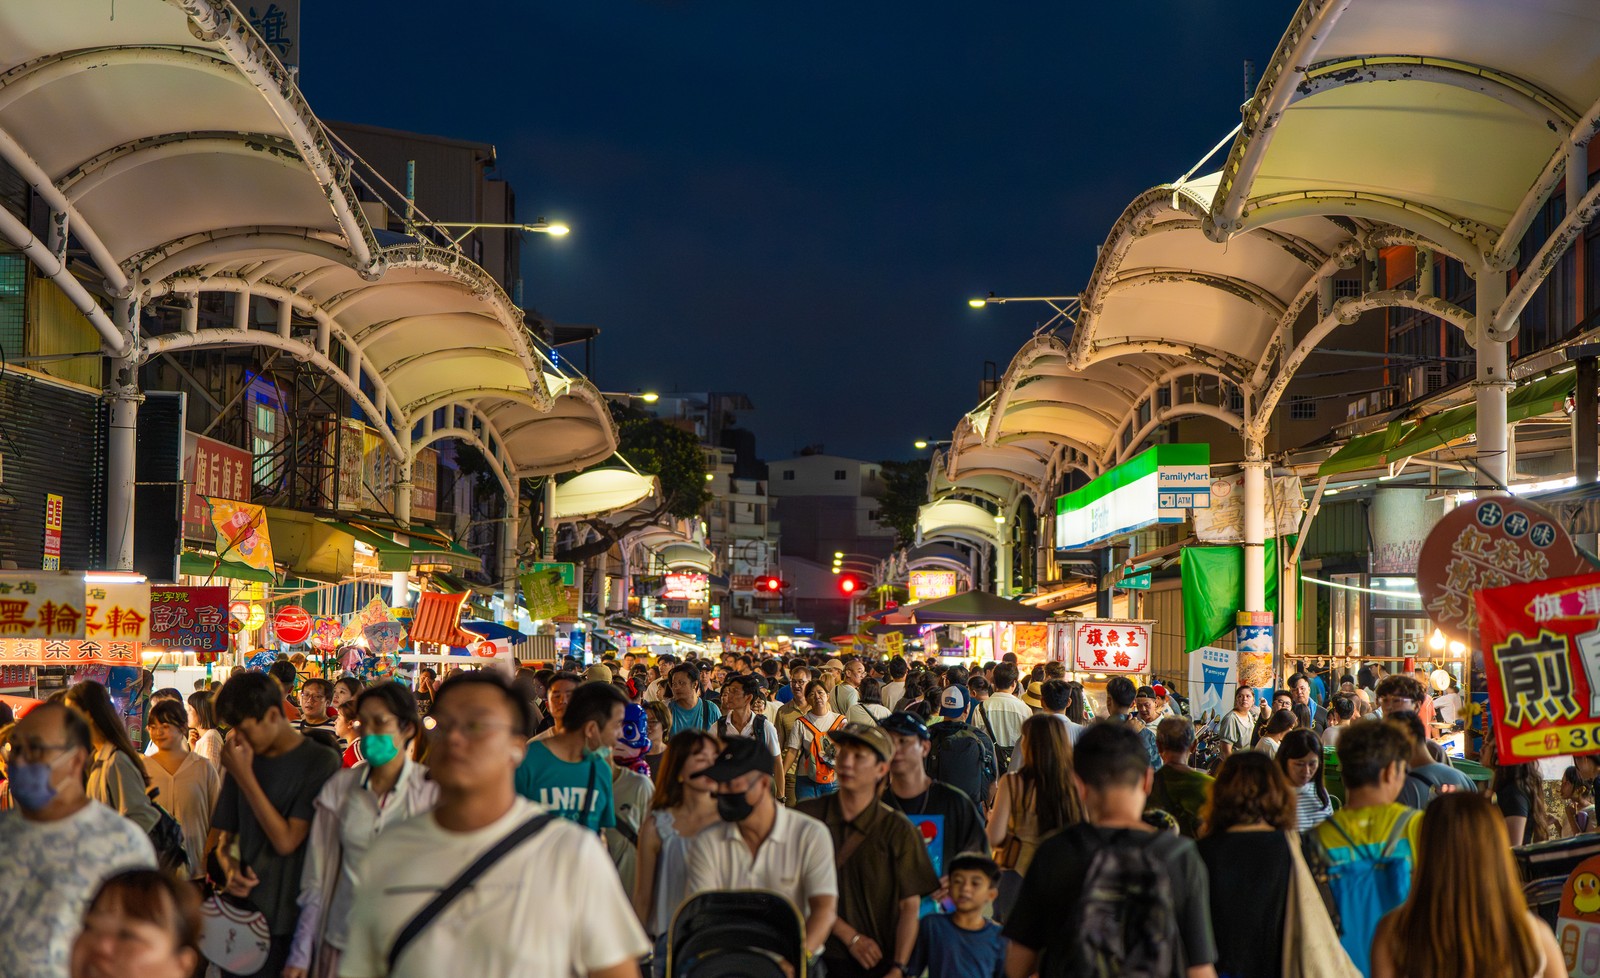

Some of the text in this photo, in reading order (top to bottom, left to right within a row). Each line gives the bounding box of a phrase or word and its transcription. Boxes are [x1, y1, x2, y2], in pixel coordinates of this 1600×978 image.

[1160, 472, 1208, 482] FamilyMart
[1178, 496, 1191, 505] ATM
[1481, 503, 1551, 546] 古早味
[1453, 524, 1549, 580] 紅茶冰
[1532, 587, 1600, 623] 旗津
[0, 600, 82, 636] 黑輪
[151, 605, 226, 633] 魷魚
[161, 634, 213, 650] nướng
[1086, 629, 1139, 648] 旗魚王
[1404, 629, 1424, 657] Fa
[1092, 649, 1132, 668] 黑輪
[1524, 732, 1561, 751] 一份
